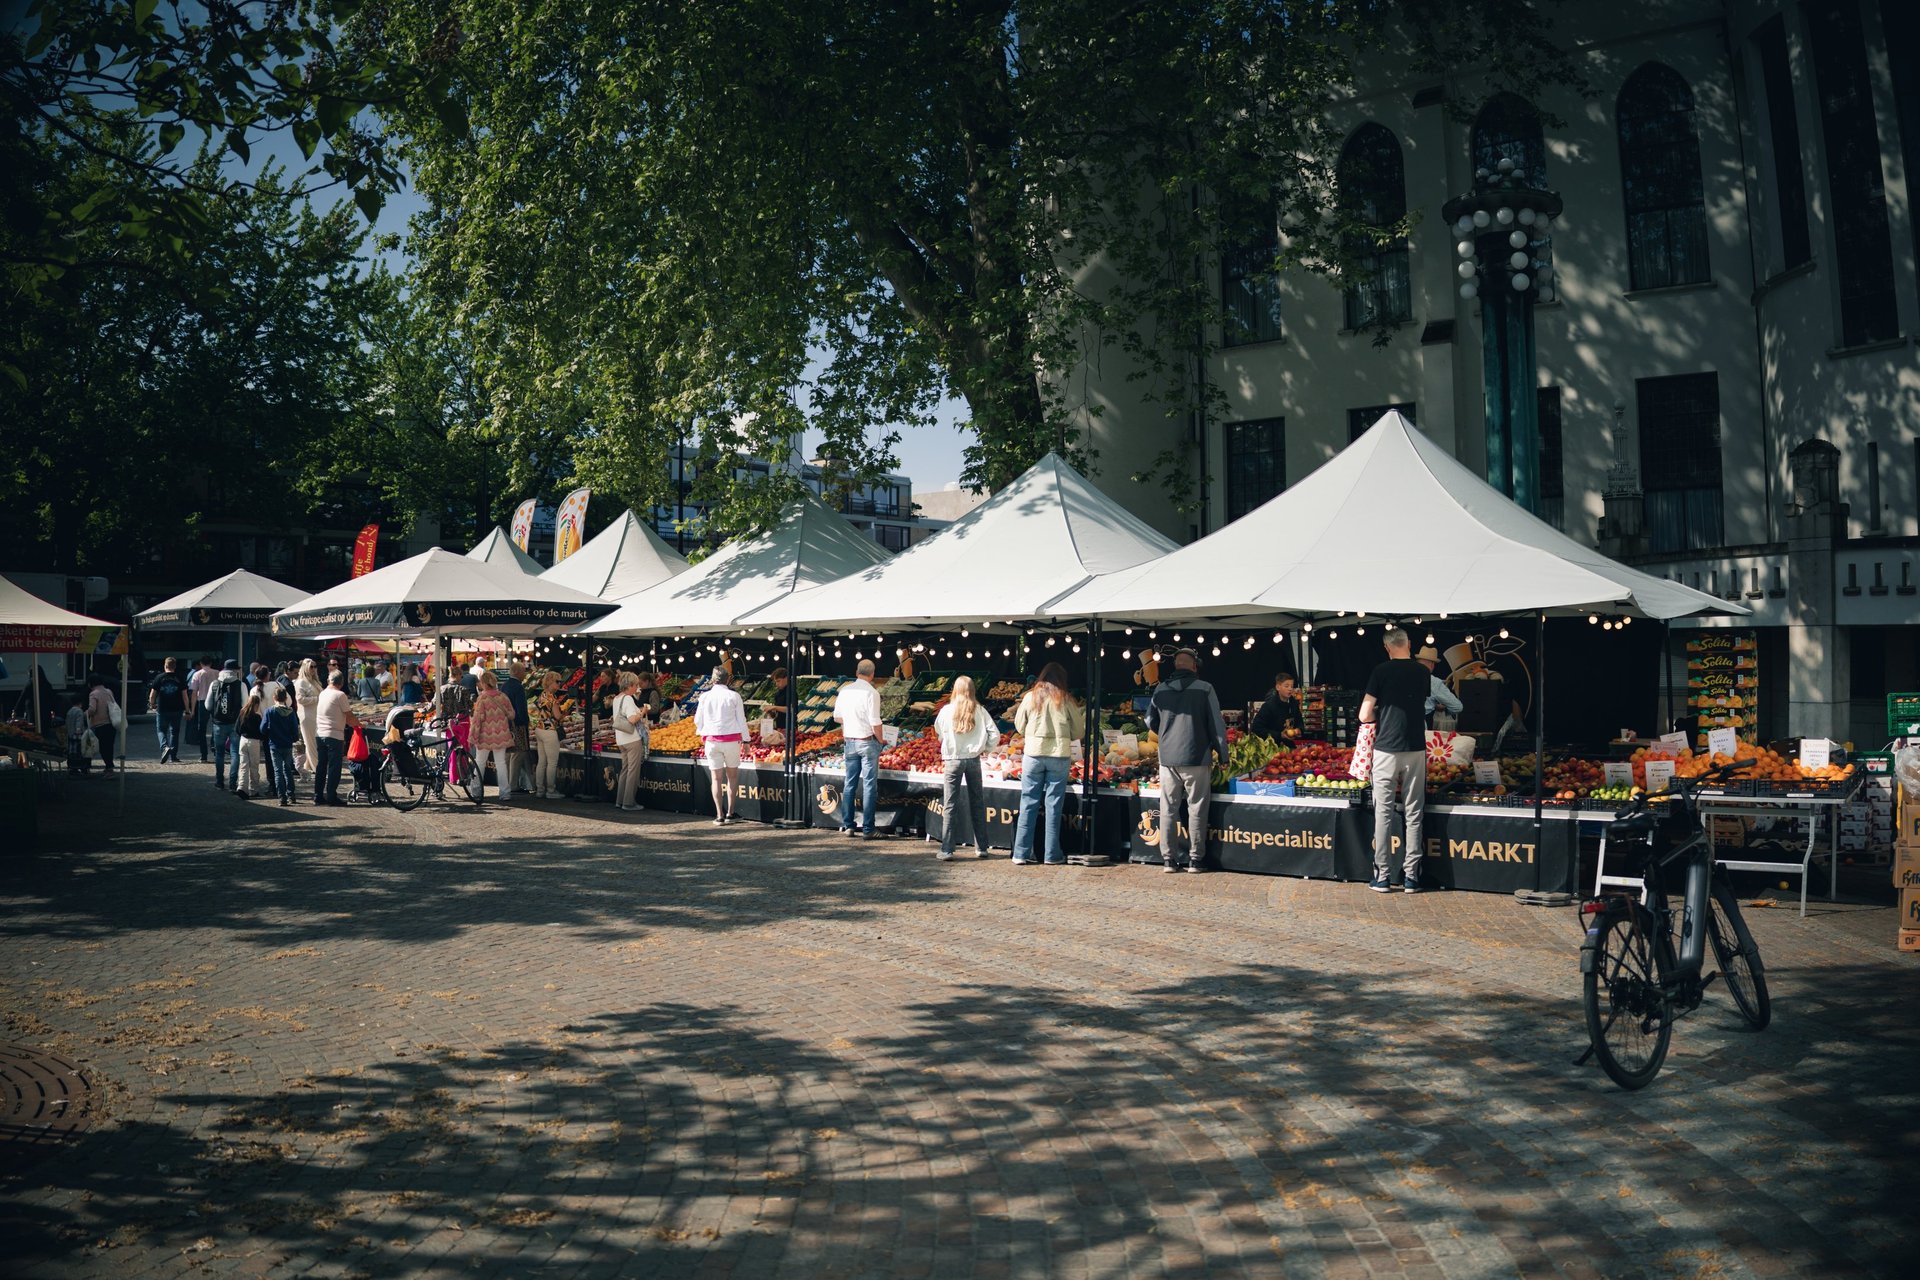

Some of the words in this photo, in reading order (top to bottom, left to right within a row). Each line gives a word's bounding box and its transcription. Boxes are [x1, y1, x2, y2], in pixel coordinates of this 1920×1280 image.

[220, 611, 234, 619] Uw
[290, 617, 300, 627] Uw
[300, 612, 337, 627] fruitspecialist
[337, 614, 346, 624] op
[346, 611, 354, 621] de
[354, 609, 374, 621] markt
[445, 608, 462, 617] Uw
[464, 606, 531, 620] fruitspecialist
[533, 608, 545, 618] op
[547, 606, 559, 617] de
[561, 608, 588, 619] markt
[34, 626, 53, 637] die
[55, 628, 85, 638] weet
[26, 636, 79, 649] betekent
[1701, 636, 1732, 650] Solita
[1702, 655, 1734, 669] Solita
[1702, 673, 1734, 688] Solita
[1710, 687, 1728, 696] Solita
[1710, 707, 1728, 716] Solita
[638, 776, 691, 794] uitspecialist
[749, 785, 786, 802] MARK
[1000, 808, 1019, 825] D
[1448, 838, 1537, 864] MARKT
